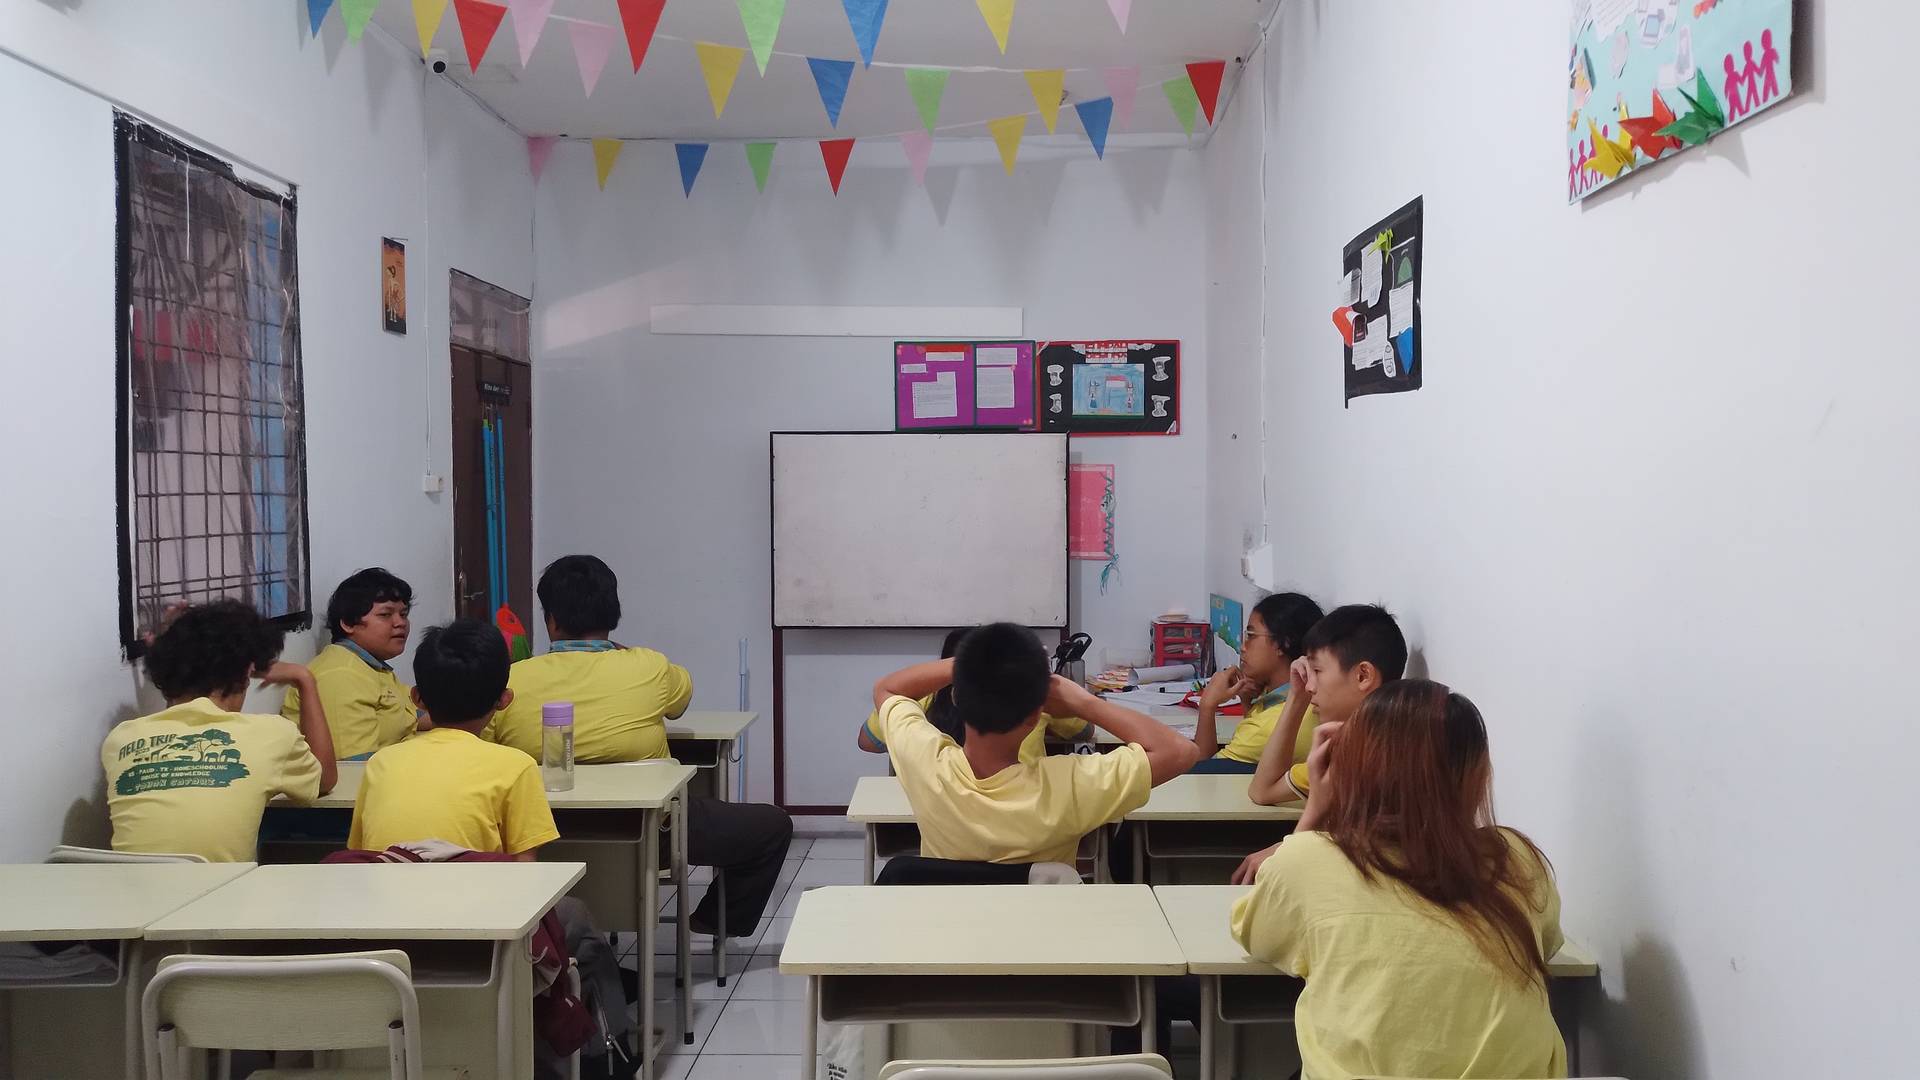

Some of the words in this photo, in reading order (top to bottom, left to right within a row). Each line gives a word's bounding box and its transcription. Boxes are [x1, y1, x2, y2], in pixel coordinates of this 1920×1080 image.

[118, 738, 145, 761] FIELD
[149, 734, 177, 748] TRIP
[173, 764, 228, 772] HOMESCHOOLING
[140, 773, 159, 781] HOUSE
